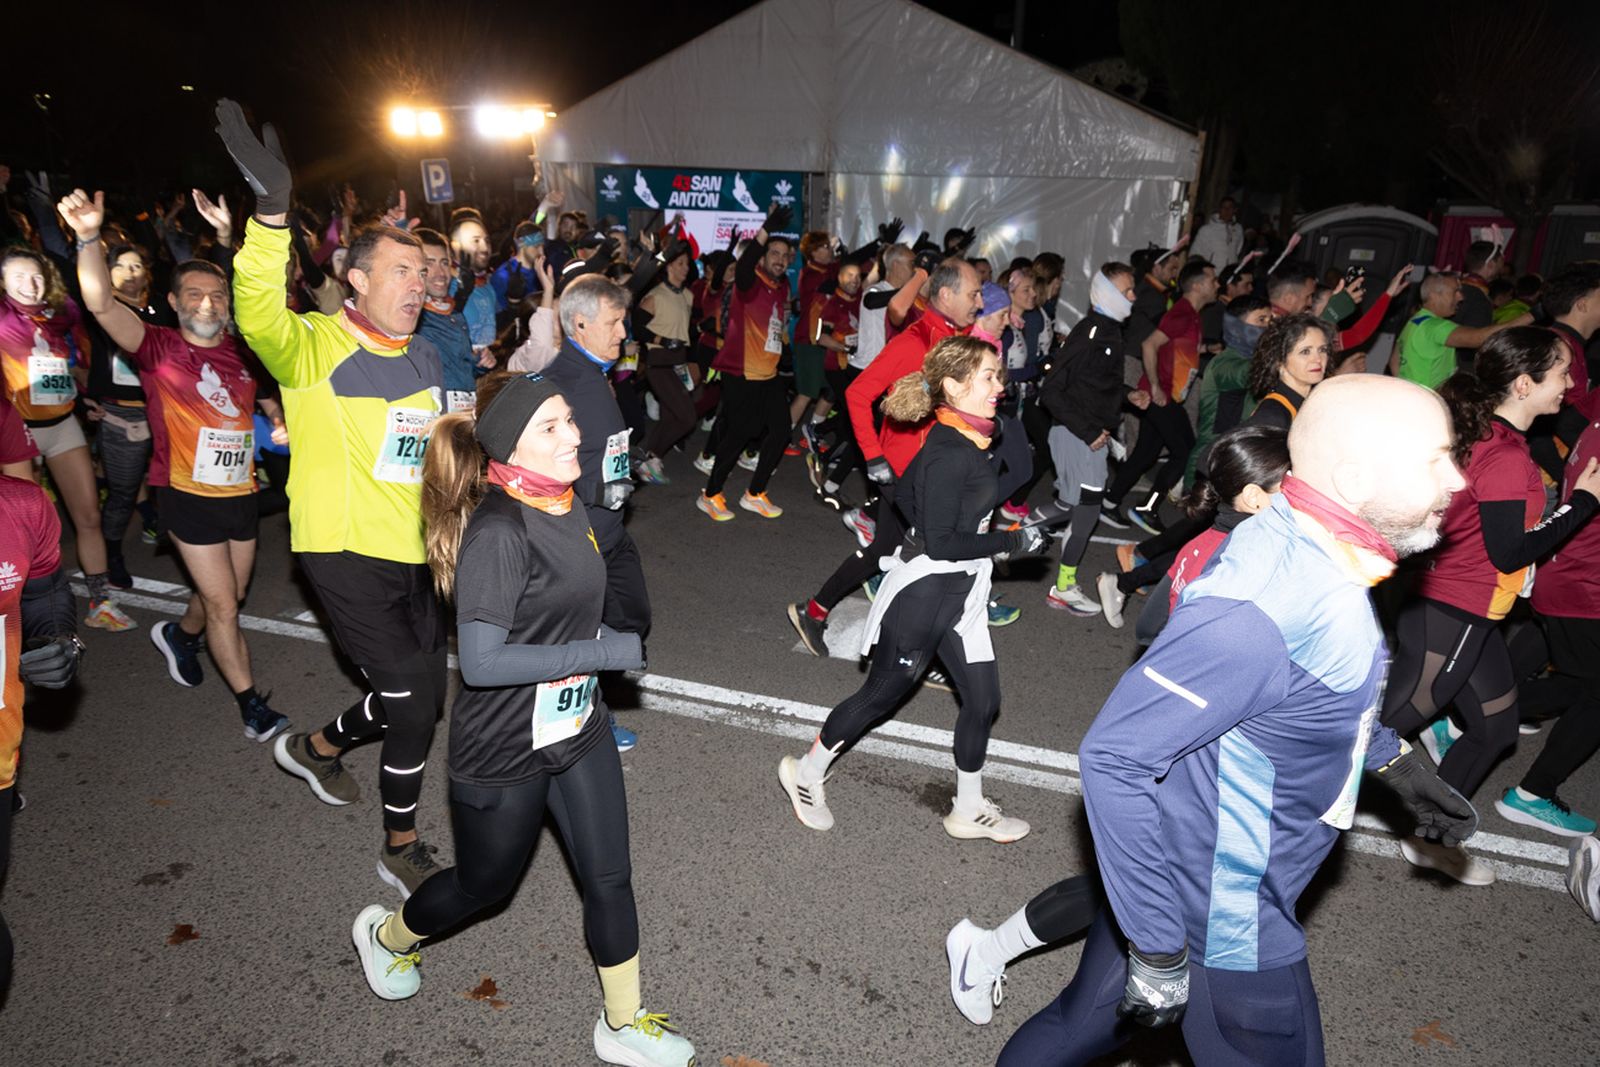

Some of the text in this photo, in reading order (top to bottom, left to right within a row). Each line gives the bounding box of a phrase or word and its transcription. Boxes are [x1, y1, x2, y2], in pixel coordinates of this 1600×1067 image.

[428, 165, 446, 189] P
[691, 175, 722, 191] SAN
[669, 189, 719, 208] ANTÓN
[42, 375, 72, 389] 3524
[209, 391, 227, 408] 43
[396, 424, 410, 434] SAN
[214, 450, 245, 467] 7014
